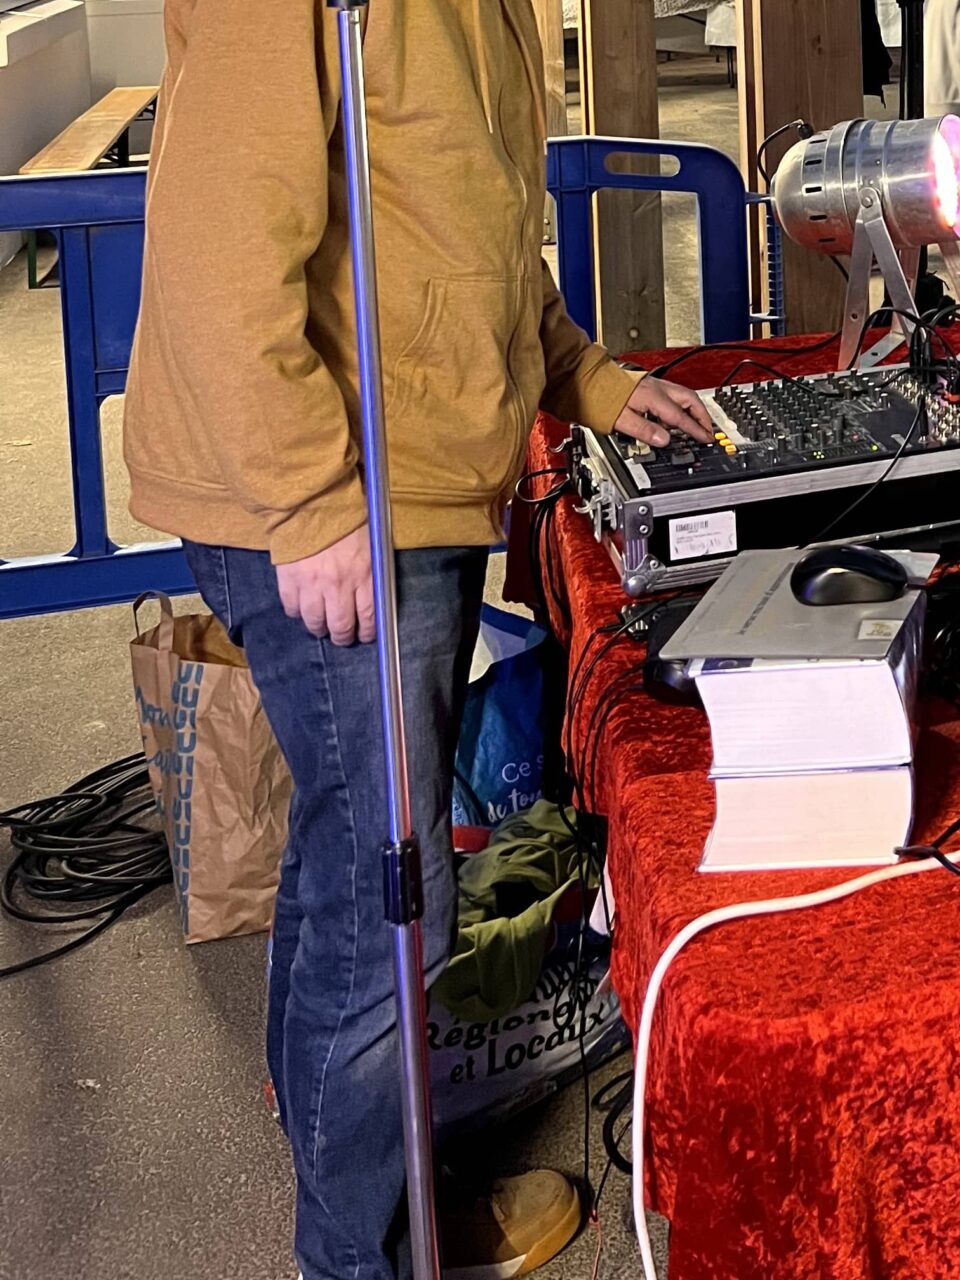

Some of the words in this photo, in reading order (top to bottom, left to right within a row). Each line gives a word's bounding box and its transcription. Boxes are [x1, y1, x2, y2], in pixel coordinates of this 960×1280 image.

[501, 761, 532, 783] Ce
[450, 1055, 476, 1084] et
[487, 1002, 605, 1077] Locaux
